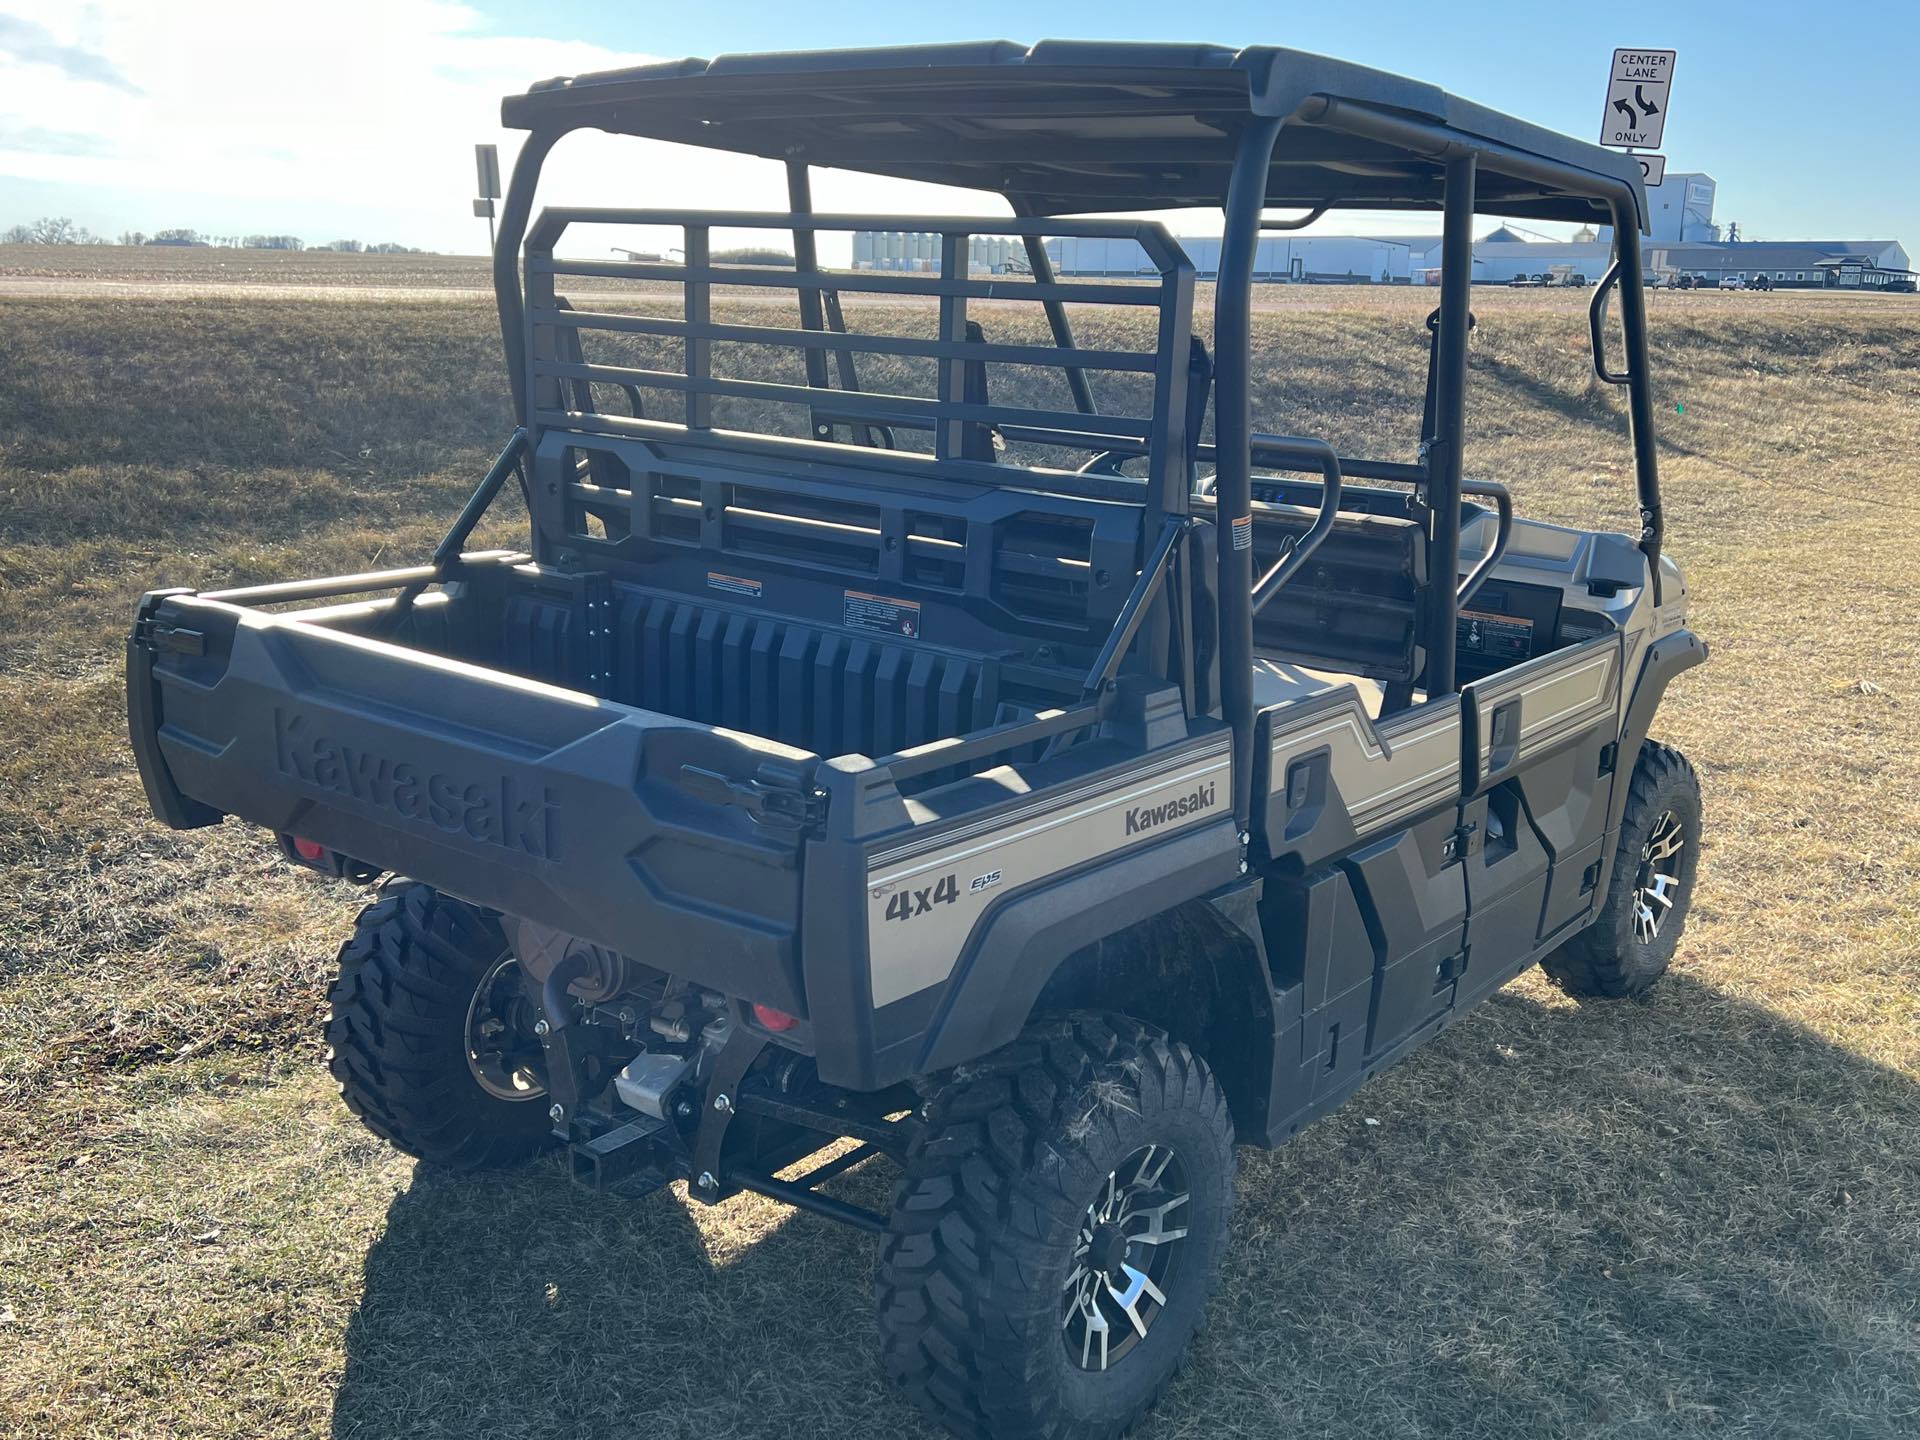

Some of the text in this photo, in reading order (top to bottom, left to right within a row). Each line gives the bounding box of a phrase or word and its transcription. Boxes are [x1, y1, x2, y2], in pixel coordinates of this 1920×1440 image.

[1621, 54, 1667, 66] CENTER
[1625, 68, 1658, 78] LANE
[1615, 132, 1647, 143] ONLY
[273, 707, 562, 864] Kawasaki
[1125, 781, 1216, 836] Kawasaki
[885, 874, 961, 921] 4x4
